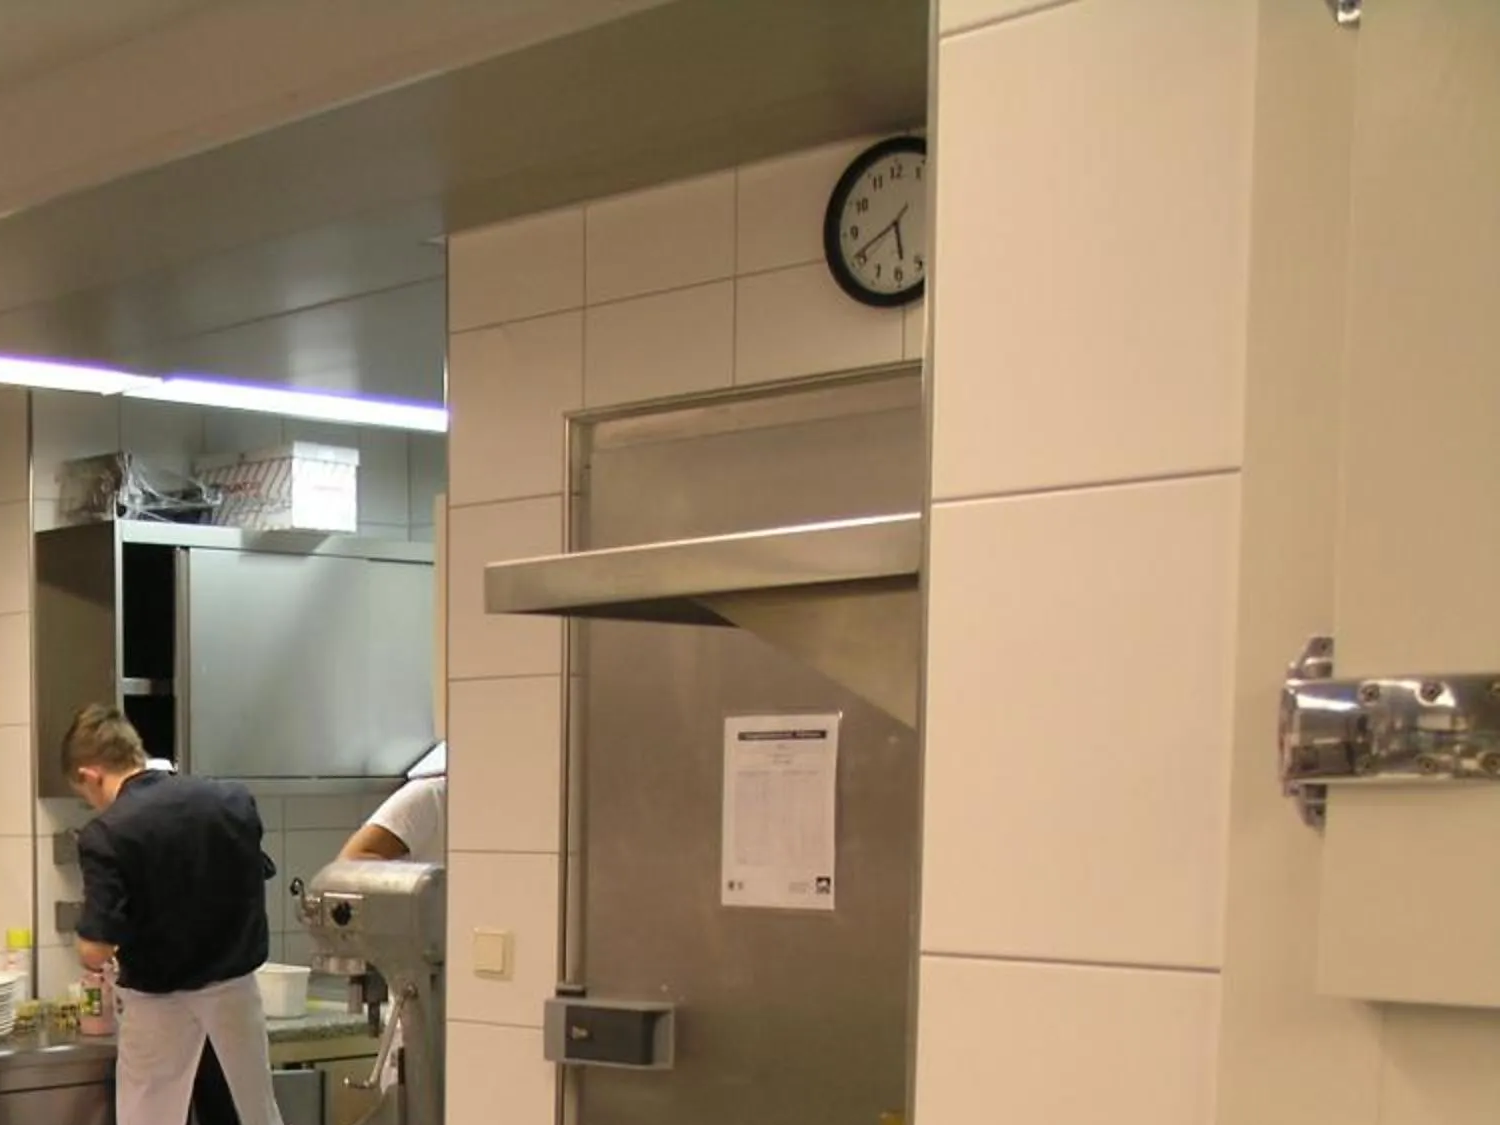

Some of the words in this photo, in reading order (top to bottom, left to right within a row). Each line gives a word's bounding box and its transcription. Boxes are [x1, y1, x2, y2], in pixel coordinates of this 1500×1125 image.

[890, 164, 903, 179] 12
[872, 175, 883, 191] 11
[856, 198, 868, 215] 10
[850, 225, 859, 240] 9
[893, 266, 903, 282] 6
